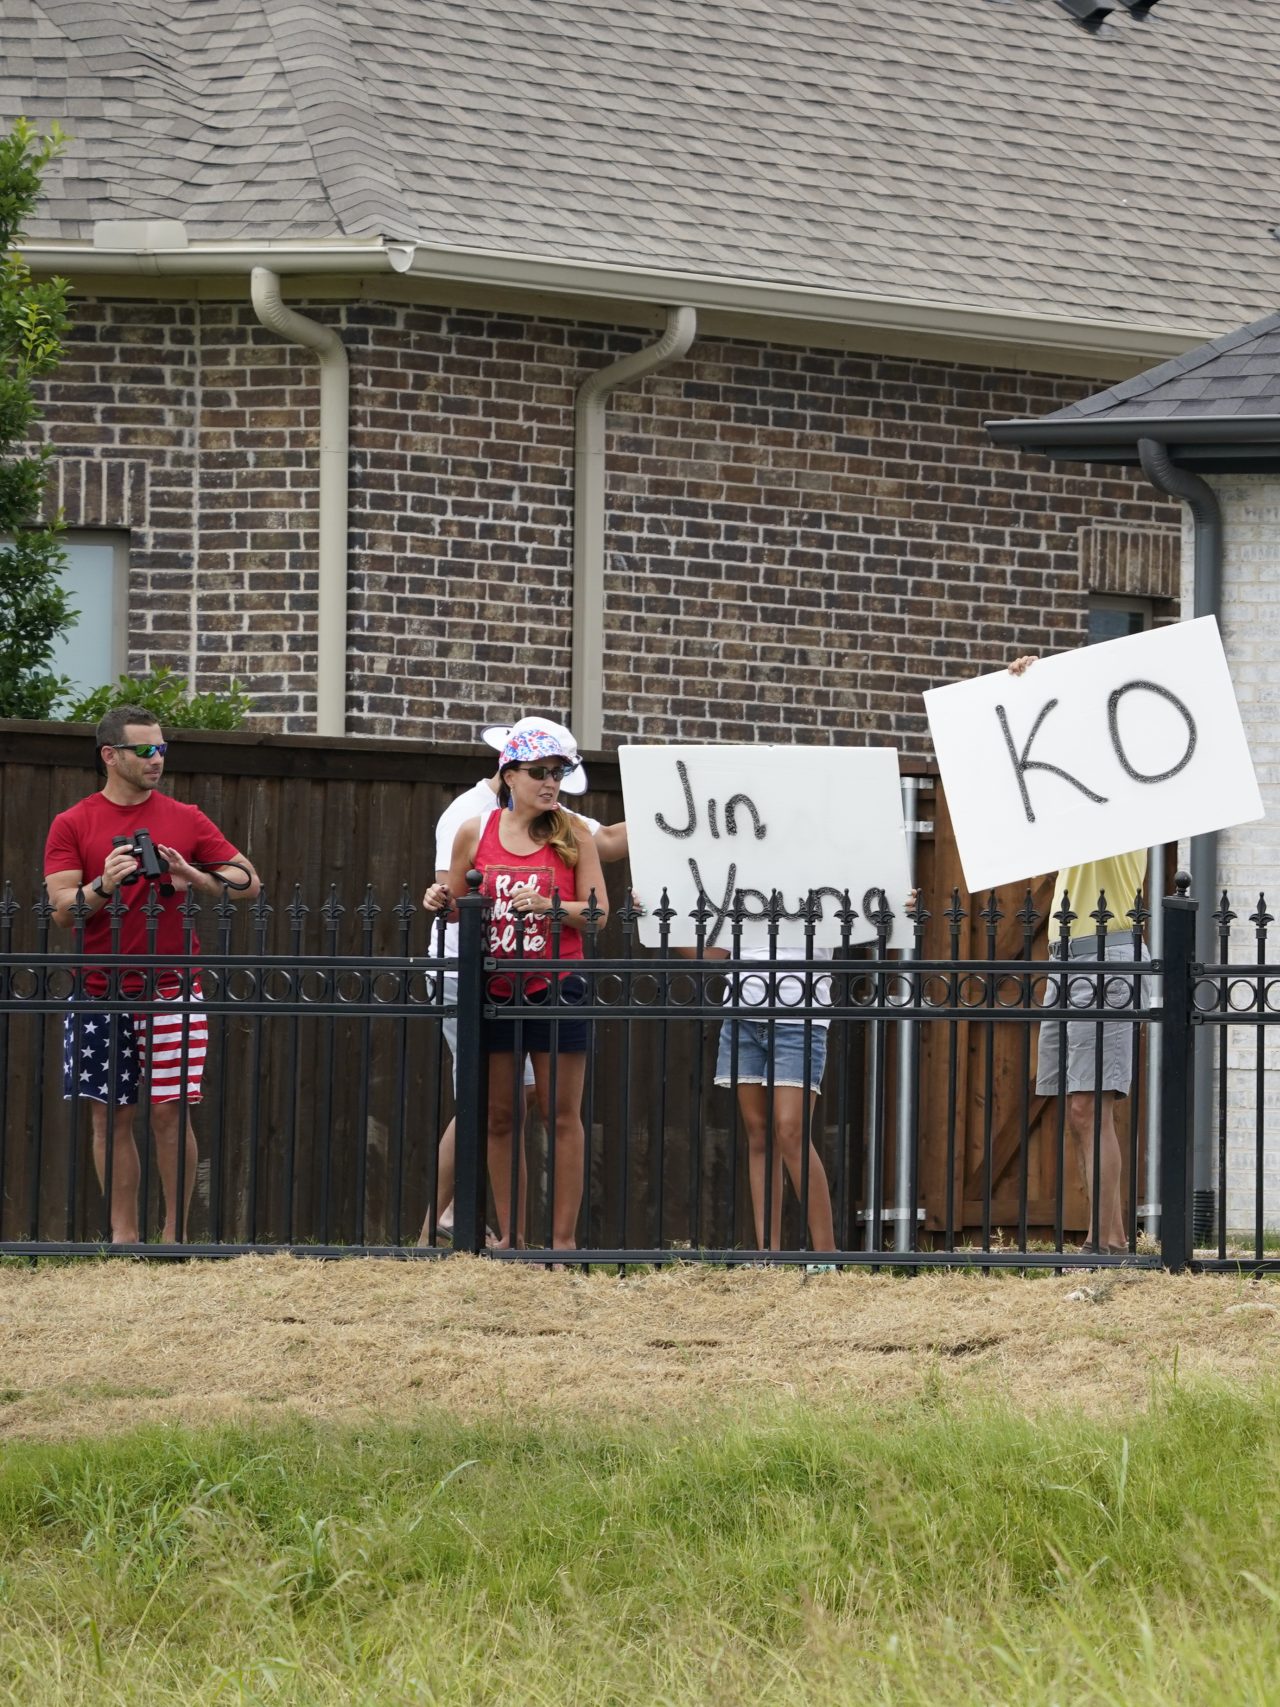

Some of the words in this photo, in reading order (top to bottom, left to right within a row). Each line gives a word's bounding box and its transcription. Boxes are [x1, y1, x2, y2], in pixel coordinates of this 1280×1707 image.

[995, 680, 1197, 823] KO
[654, 760, 767, 840] Jin
[688, 857, 894, 948] Young
